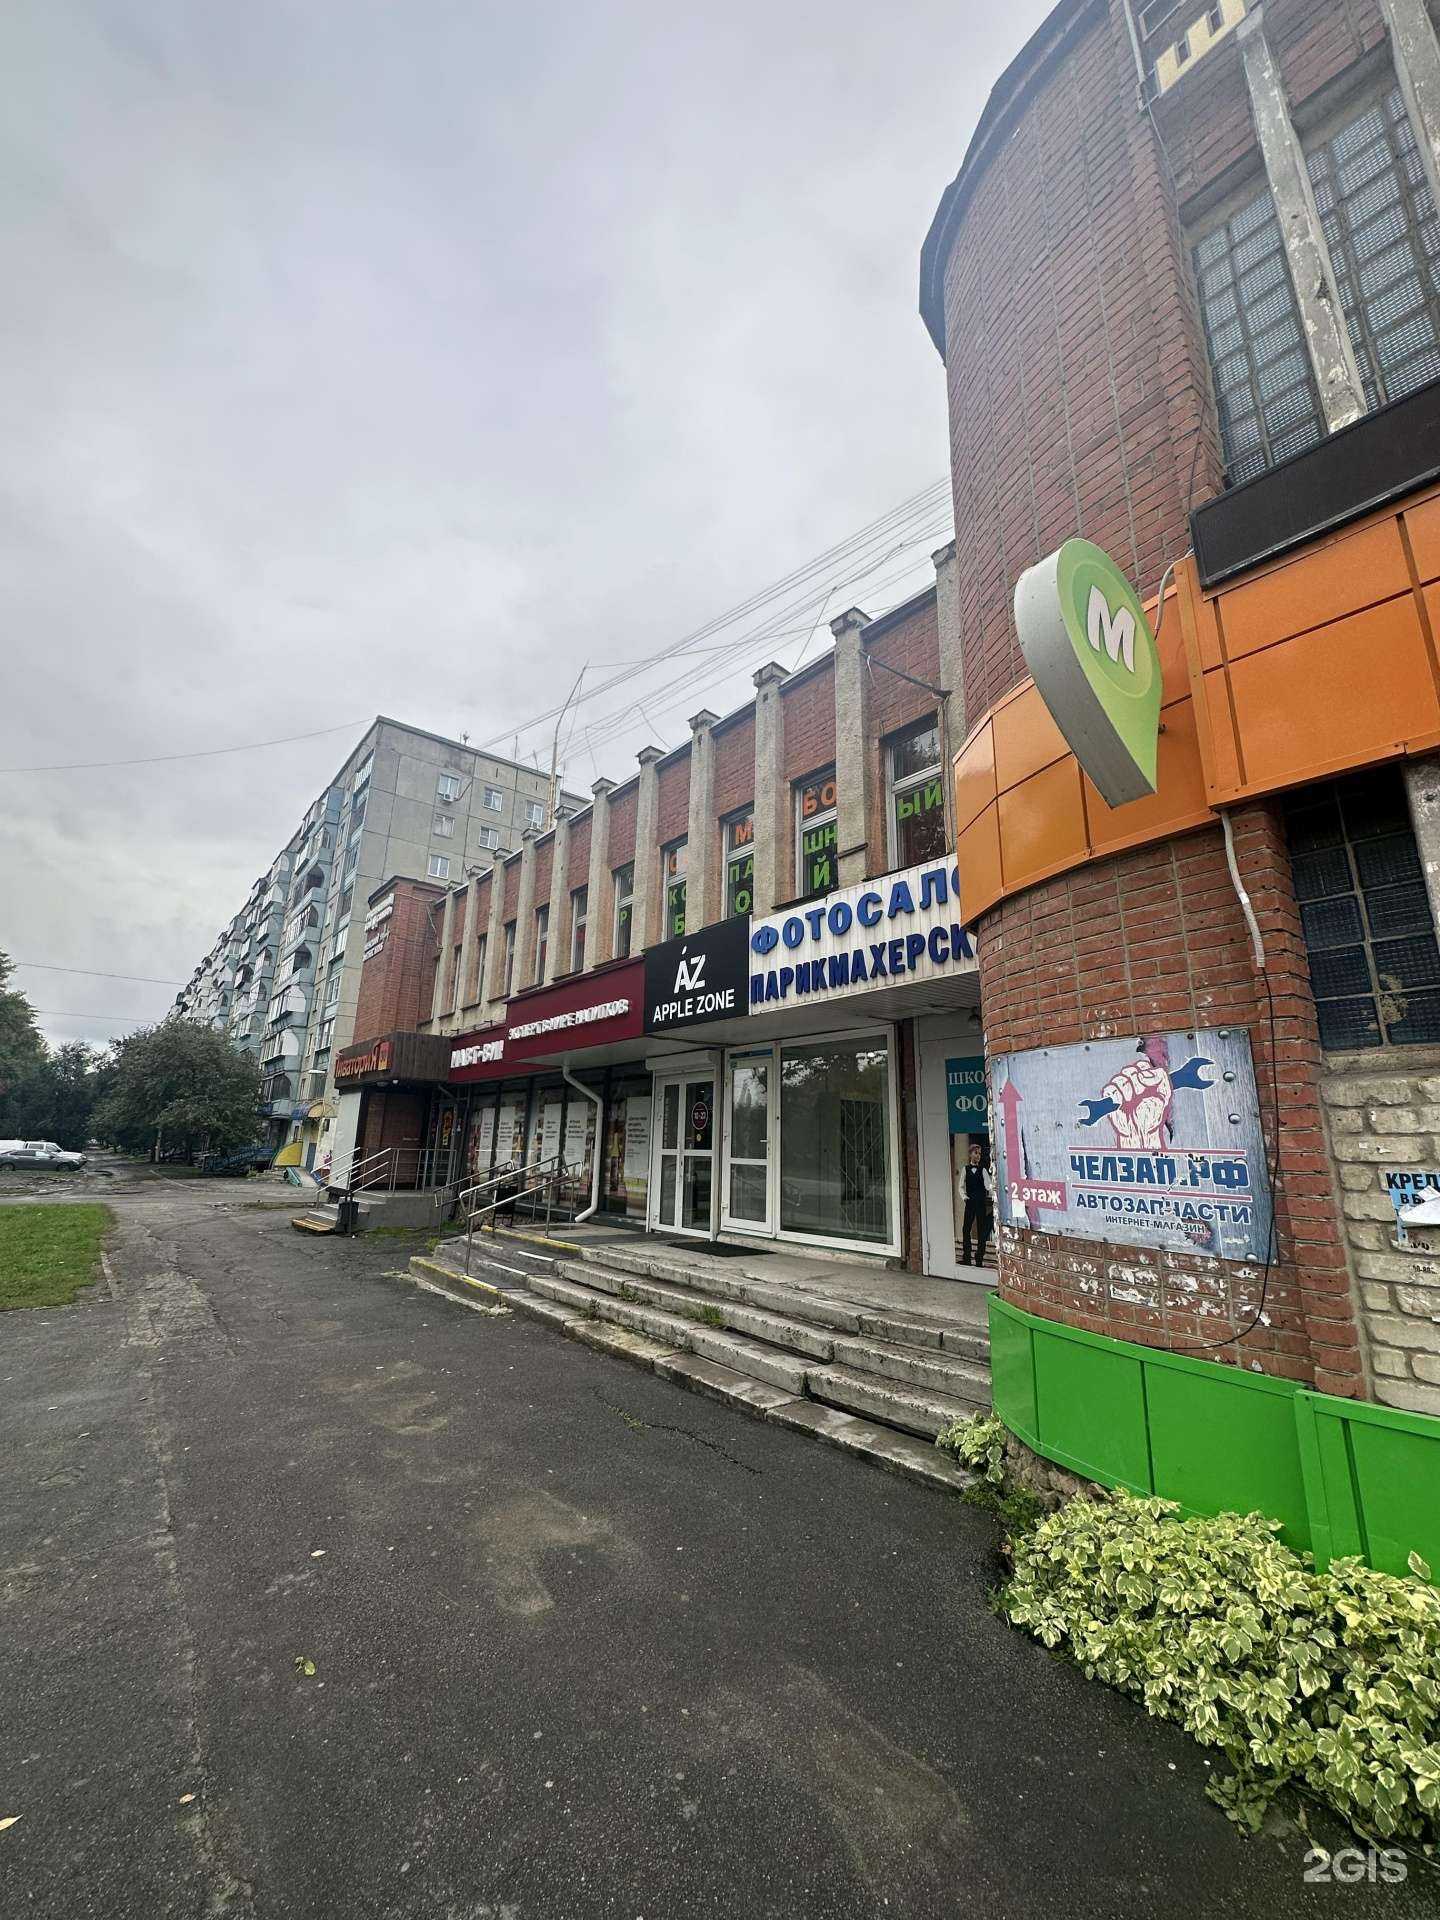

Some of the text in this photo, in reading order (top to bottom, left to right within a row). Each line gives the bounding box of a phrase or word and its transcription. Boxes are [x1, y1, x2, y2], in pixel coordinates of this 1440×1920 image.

[653, 989, 735, 1023] APPLE ZONE
[948, 1070, 985, 1085] ШКО
[955, 1094, 988, 1112] ФО
[1070, 1154, 1250, 1189] ЧЕЛЗАП.РФ
[1011, 1182, 1062, 1205] 2 этаж
[1076, 1193, 1251, 1225] АВТОЗАПЧАСТИ
[1105, 1214, 1207, 1234] ИНТЕРНЕТ-МАГАЗИН
